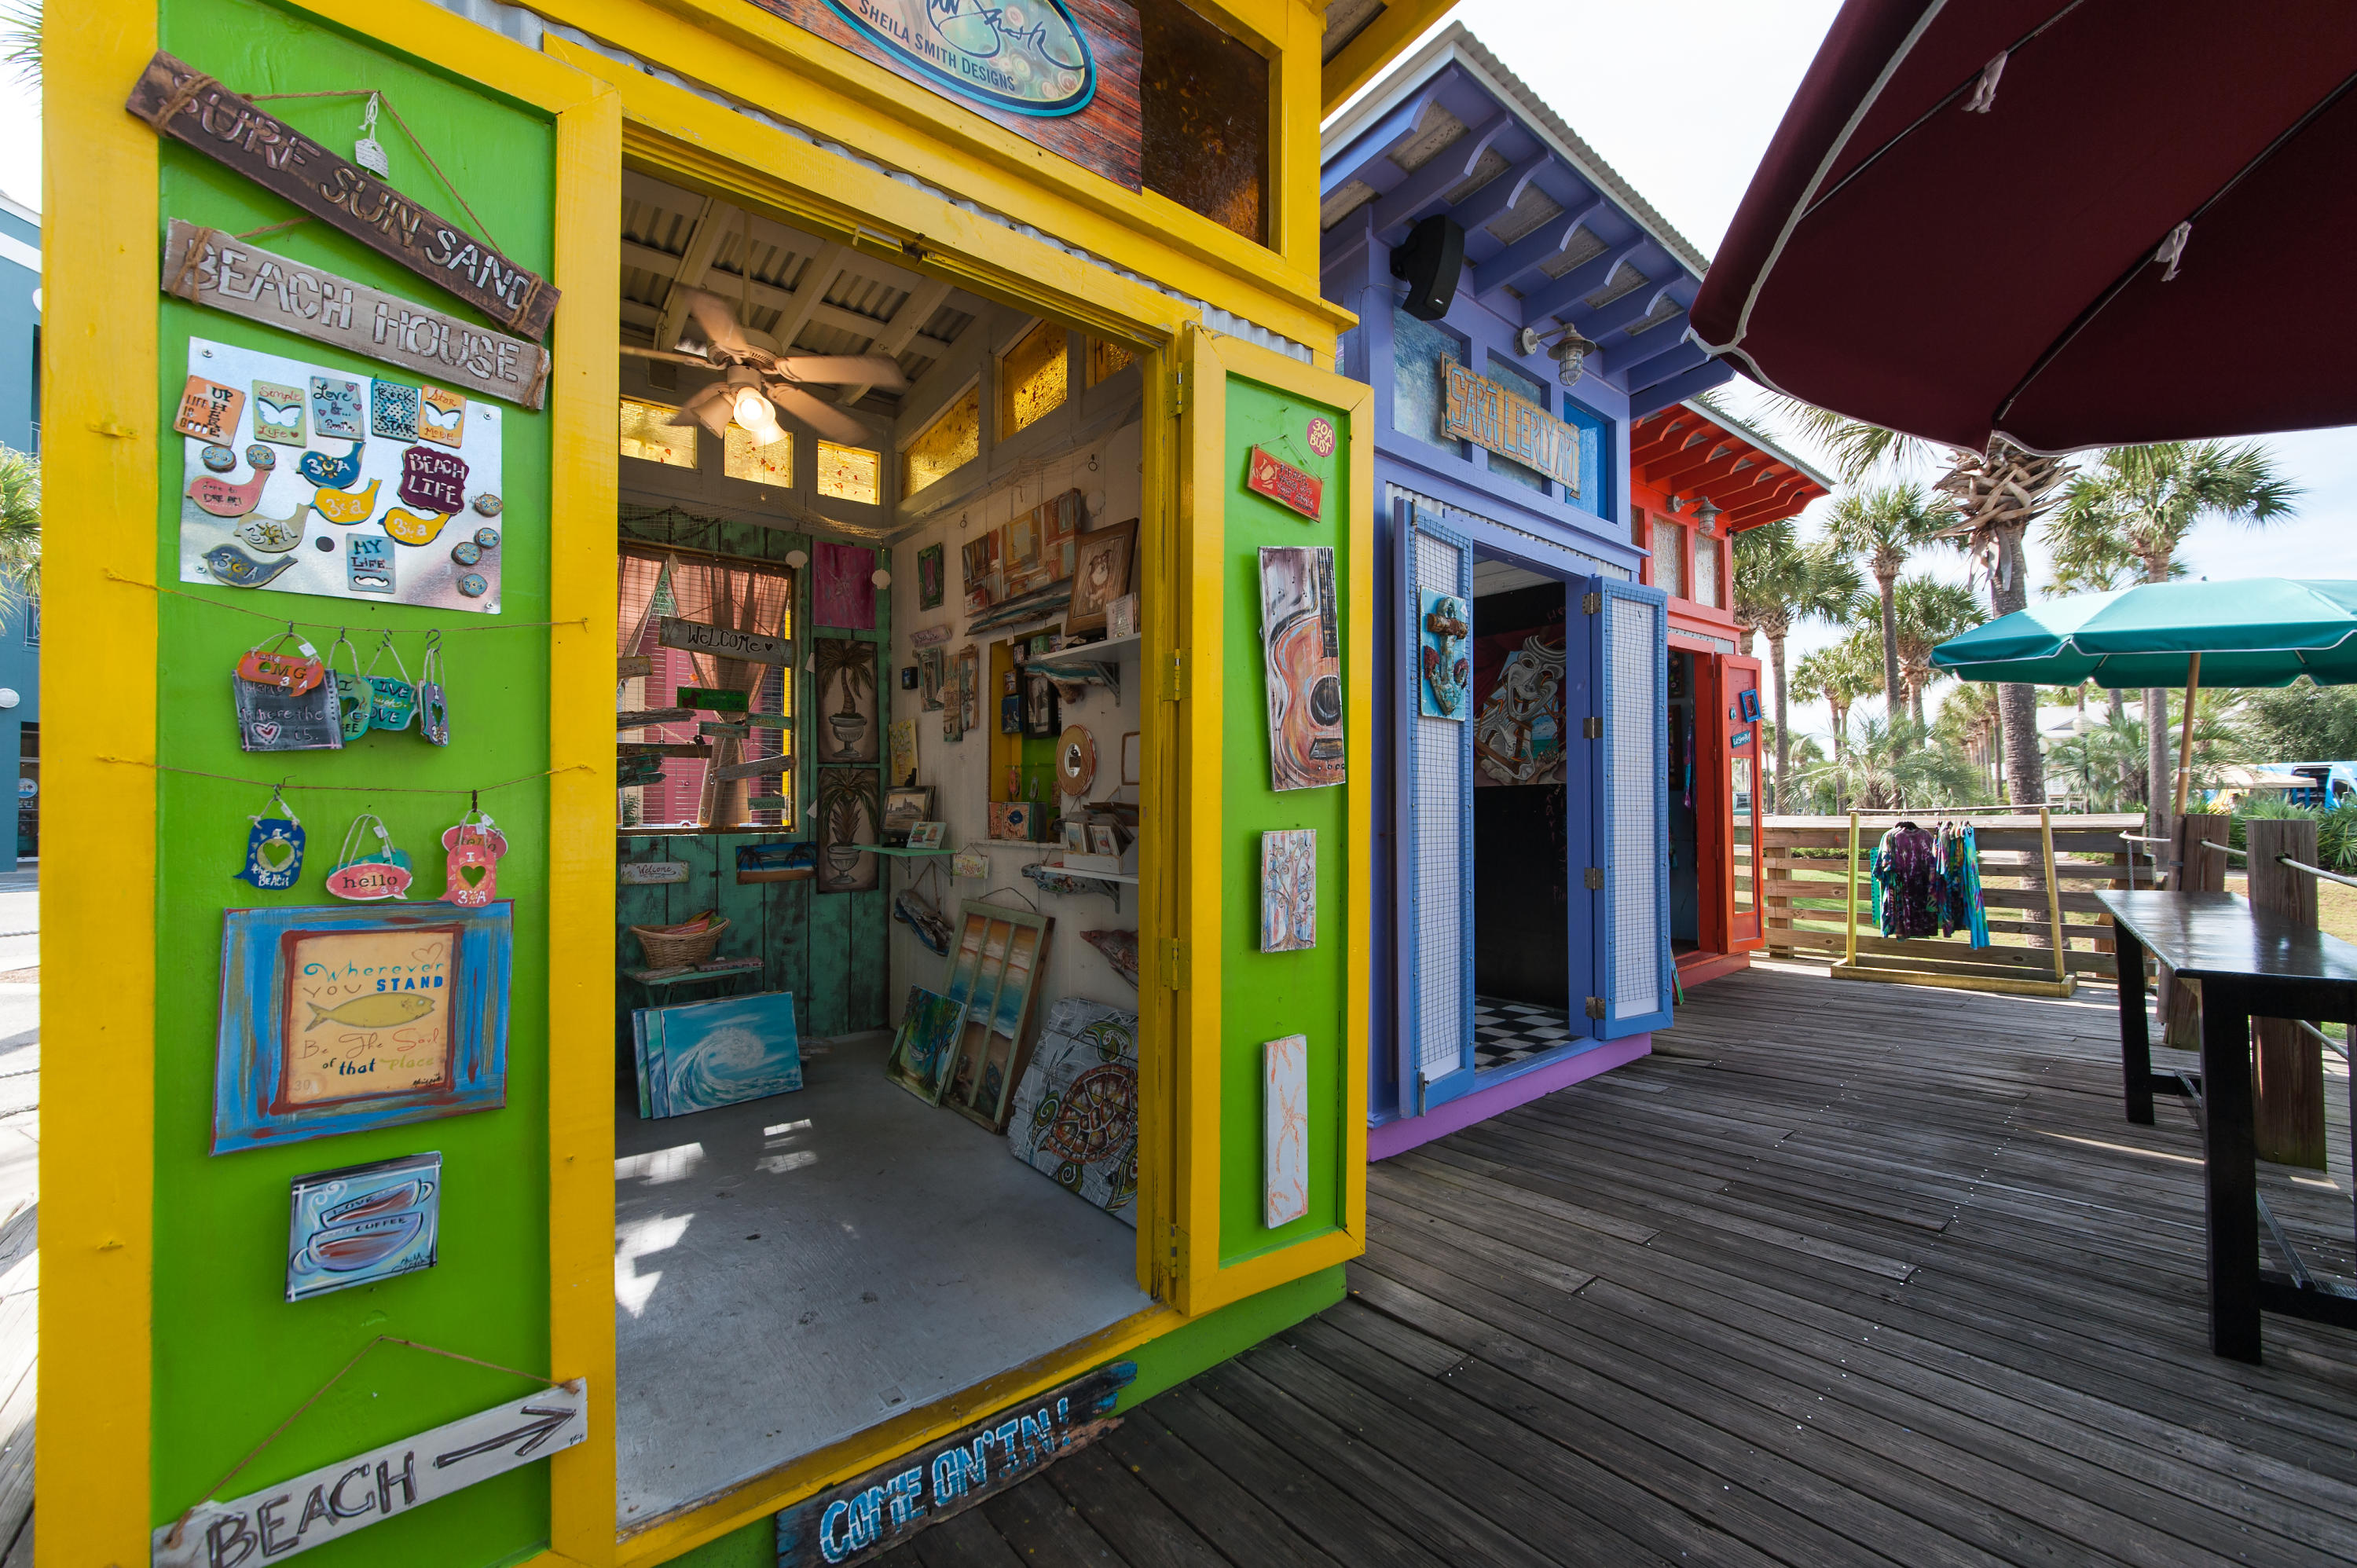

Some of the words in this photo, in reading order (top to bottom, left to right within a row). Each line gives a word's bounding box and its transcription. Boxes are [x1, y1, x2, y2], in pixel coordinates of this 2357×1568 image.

[859, 0, 910, 40] SHEILA
[915, 33, 957, 69] SMITH
[962, 58, 1016, 91] DESIGNS
[320, 166, 423, 247] SUN
[424, 229, 531, 311] SAND
[187, 238, 354, 331] BEACH
[373, 301, 521, 383] HOUSE
[211, 387, 233, 402] UP
[313, 384, 353, 401] Love
[1450, 367, 1498, 446] SARA
[1310, 434, 1331, 454] BUST
[1313, 419, 1333, 445] 30A
[409, 453, 465, 480] BEACH
[408, 475, 460, 506] LIFE
[354, 539, 383, 555] MY
[339, 680, 353, 691] I
[343, 874, 398, 889] hello
[303, 959, 445, 983] Wherever
[376, 976, 444, 992] STAND
[299, 1039, 329, 1059] Be
[339, 1032, 383, 1059] The
[393, 1028, 439, 1052] Soul
[323, 1057, 337, 1069] of
[339, 1058, 376, 1076] that
[380, 1054, 434, 1071] place
[206, 1450, 419, 1568] BEACH
[819, 1466, 927, 1564] COME
